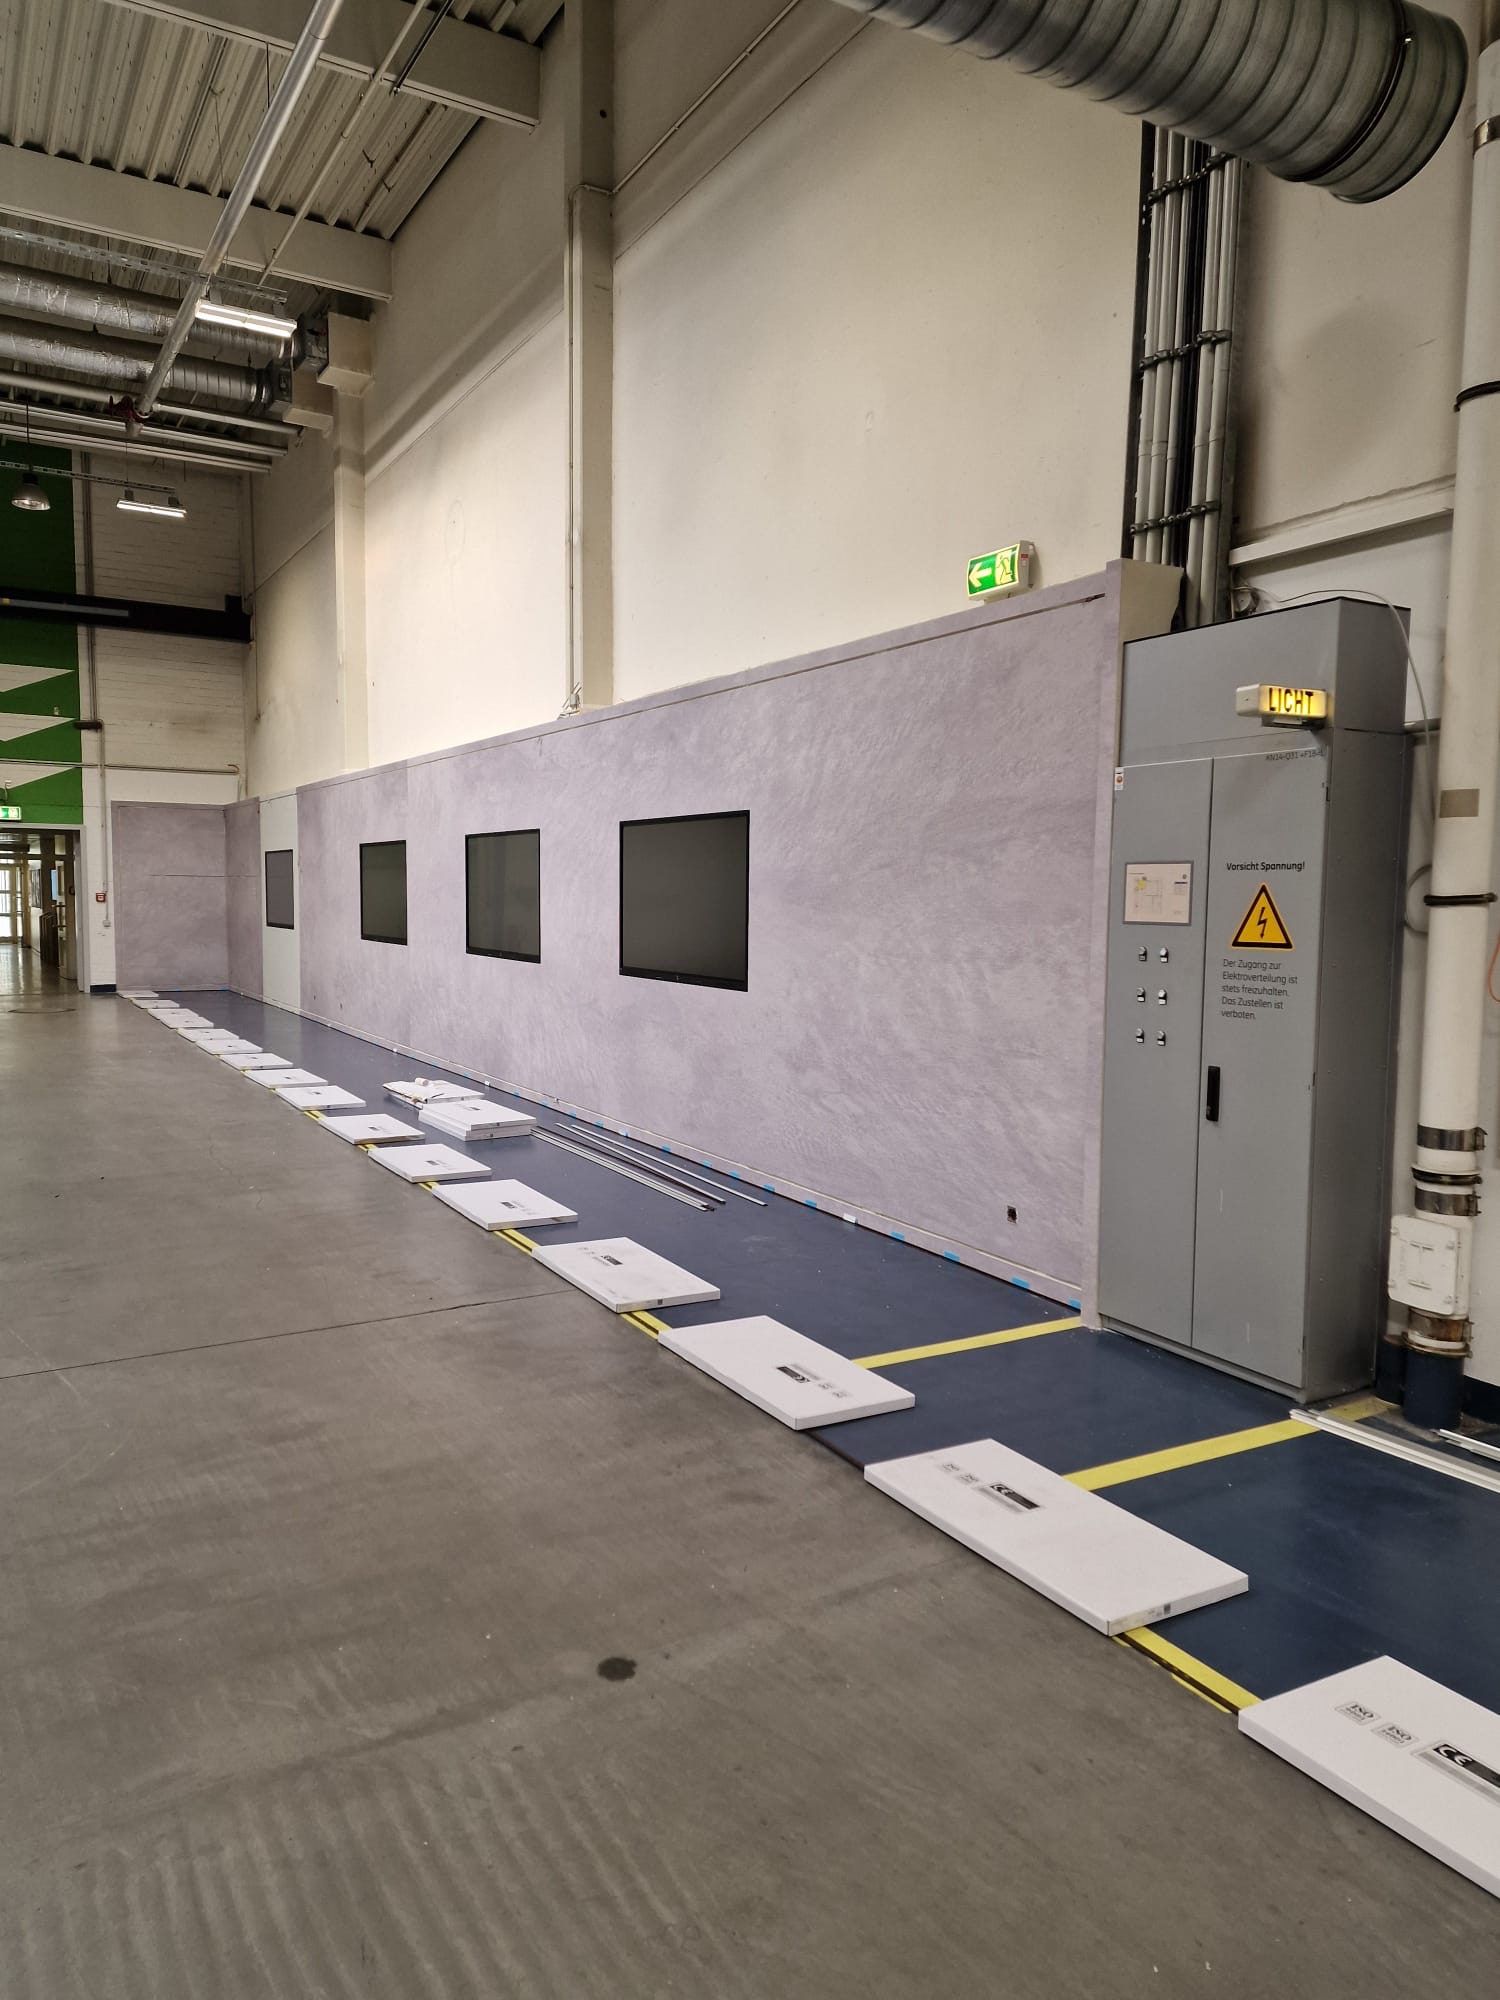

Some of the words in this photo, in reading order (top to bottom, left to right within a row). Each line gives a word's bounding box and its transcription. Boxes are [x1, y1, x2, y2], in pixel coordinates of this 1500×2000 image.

[1269, 687, 1314, 714] LICHT
[1226, 861, 1259, 871] Vorsicht
[1260, 861, 1305, 872] Spannung!
[1223, 958, 1236, 967] Der
[1238, 959, 1267, 971] Zugang
[1268, 962, 1281, 970] zur
[1222, 971, 1287, 985] Elektroverteilung
[1288, 975, 1298, 984] ist
[1222, 984, 1240, 993] stets
[1221, 996, 1236, 1006] Das
[1237, 997, 1273, 1008] Zustellen
[1274, 1000, 1284, 1010] ist
[1350, 1704, 1374, 1718] ISO
[1387, 1725, 1412, 1740] ISO
[1439, 1746, 1473, 1766] CE
